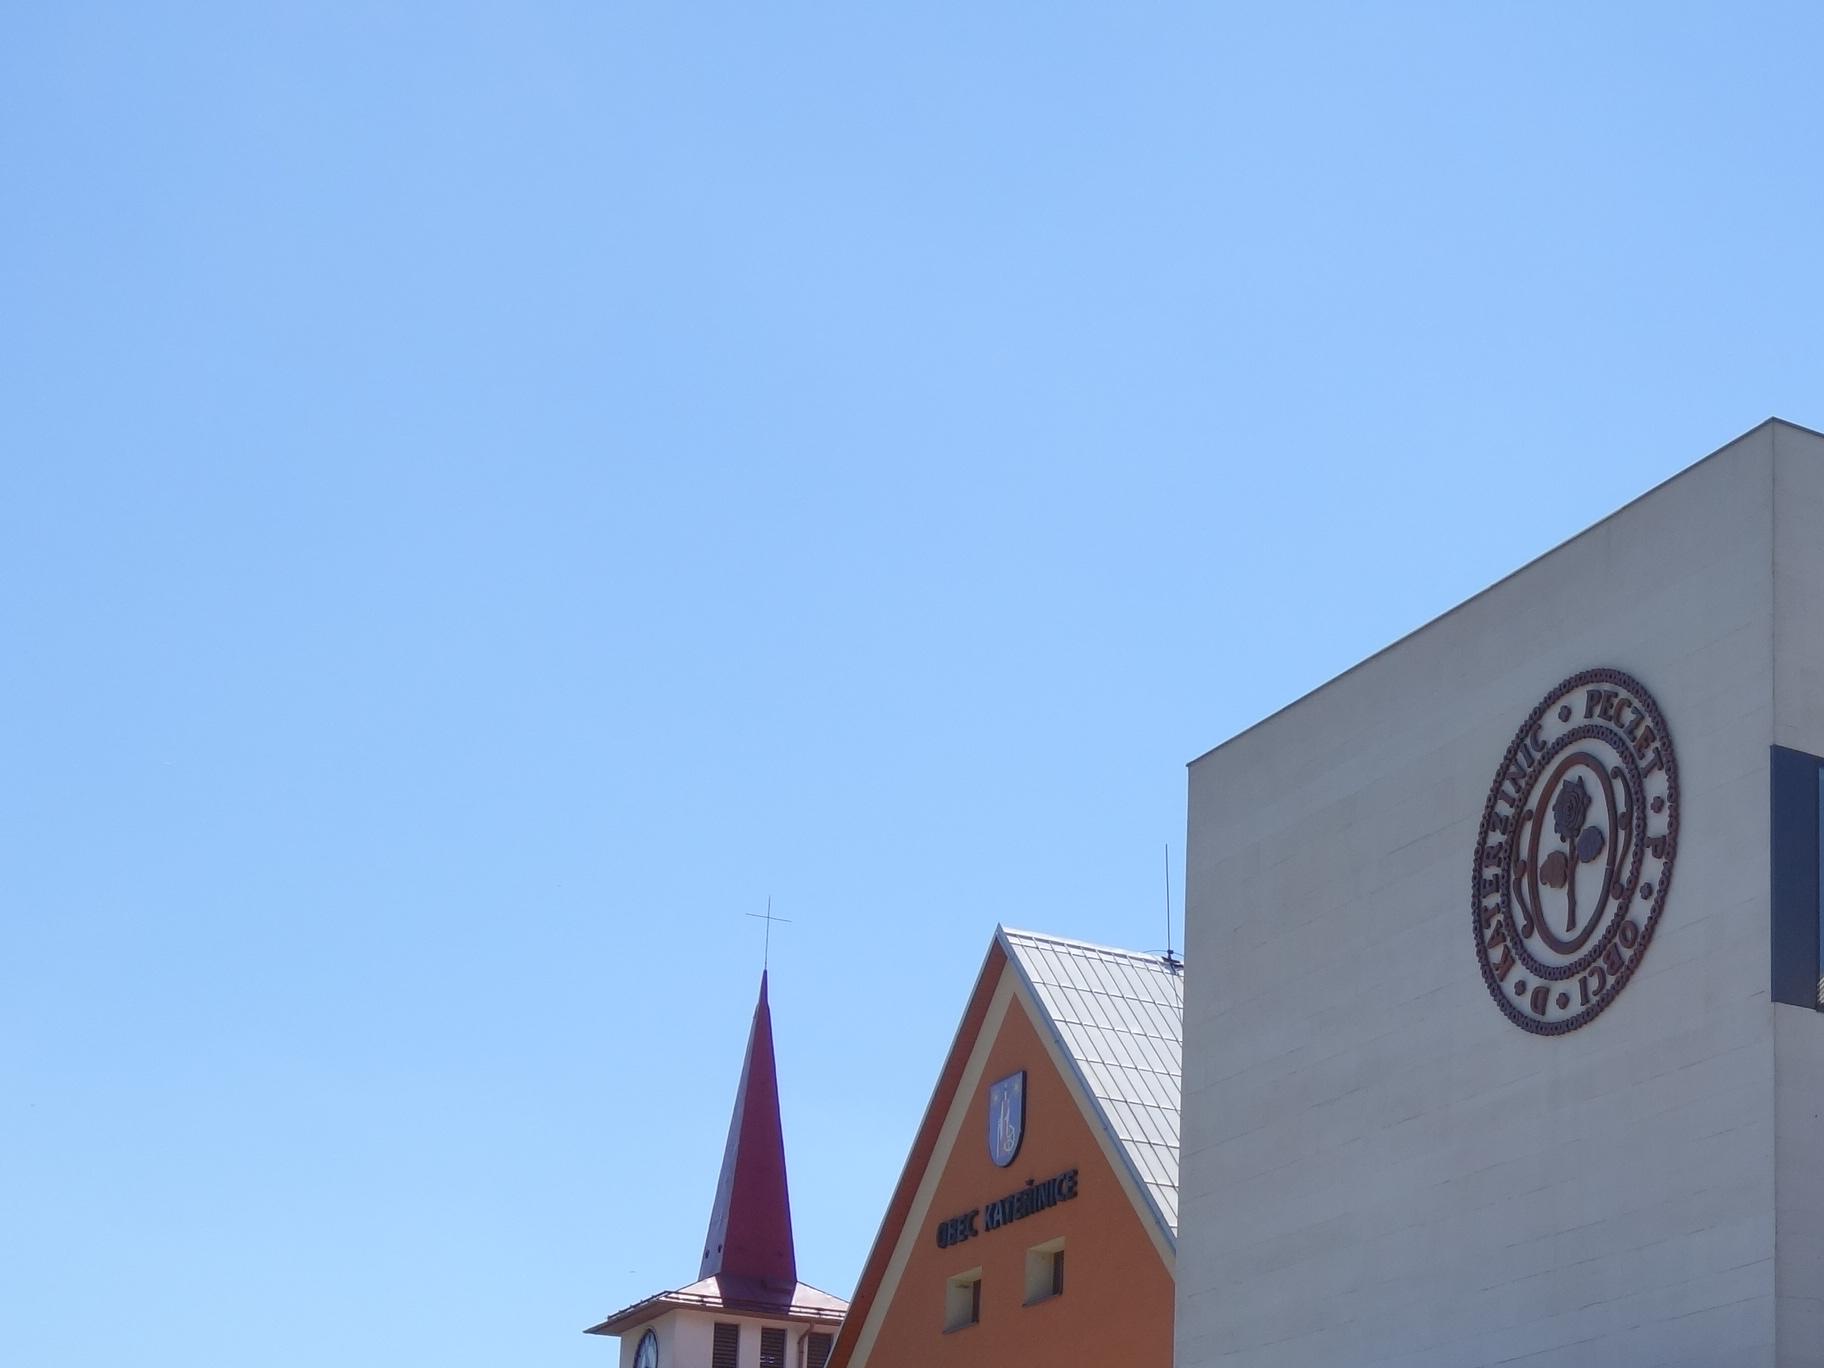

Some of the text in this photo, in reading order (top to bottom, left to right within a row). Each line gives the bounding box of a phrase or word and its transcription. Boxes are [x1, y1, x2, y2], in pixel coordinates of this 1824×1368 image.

[1584, 689, 1664, 779] PECZET
[1646, 836, 1666, 859] P
[1530, 985, 1550, 1016] D
[1579, 920, 1638, 1006] OBCI
[936, 1168, 1078, 1249] OBEC KATEŘINICE
